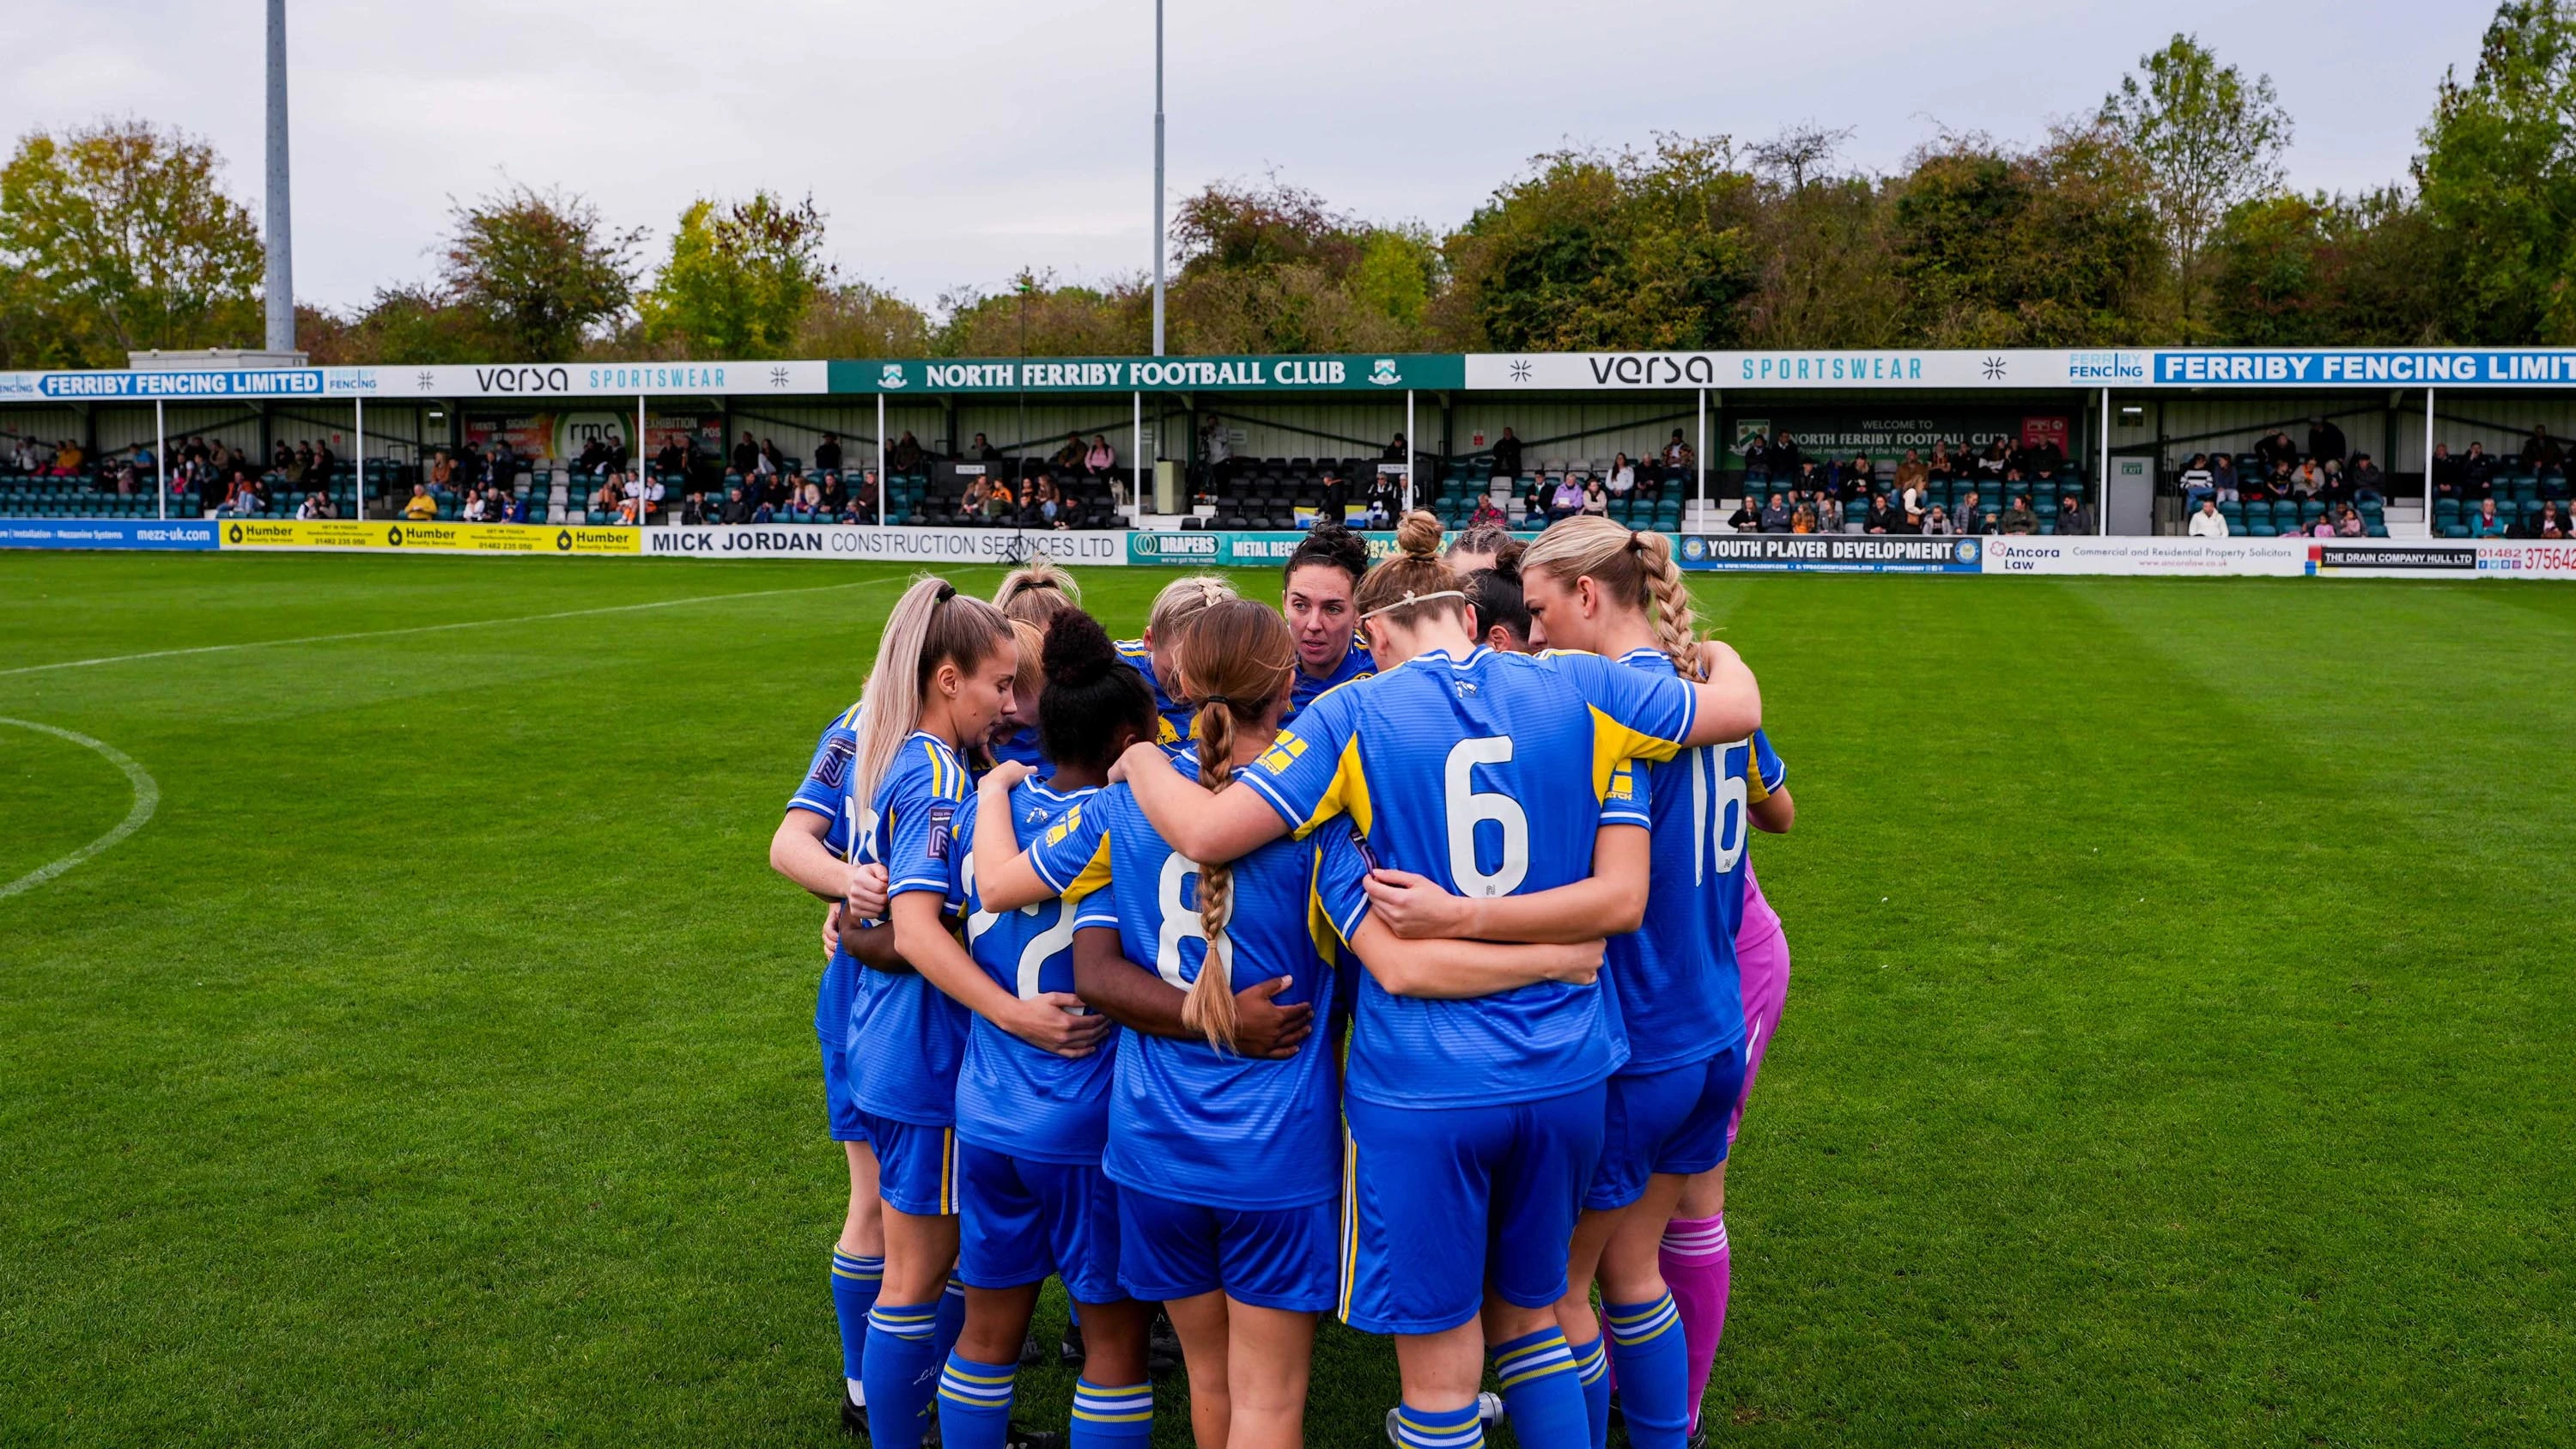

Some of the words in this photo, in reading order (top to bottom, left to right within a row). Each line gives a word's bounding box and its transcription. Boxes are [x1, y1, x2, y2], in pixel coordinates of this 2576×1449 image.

[927, 364, 1014, 387] NORTH
[1022, 363, 1122, 387] FERRIBY
[1129, 362, 1266, 385] FOOTBALL
[1273, 361, 1346, 384] CLUB
[1742, 358, 1922, 380] SPORTSWEAR
[2069, 358, 2142, 377] FENCING
[2165, 356, 2312, 380] FERRIBY
[2323, 356, 2476, 380] FENCING
[2488, 356, 2576, 380] LIMIT
[46, 375, 131, 395] FERRIBY
[136, 374, 227, 394] FENCING
[233, 373, 318, 393] LIMITED
[330, 373, 376, 389] FENCING
[590, 368, 726, 387] SPORTSWEAR
[570, 423, 616, 441] rmc
[1862, 420, 1915, 429] WELCOME
[1917, 420, 1933, 429] TO
[1789, 433, 1835, 446] NORTH
[1839, 433, 1893, 445] FERRIBY
[137, 527, 210, 541] mezz-uk.com
[246, 525, 293, 536] Humber
[406, 527, 457, 539] Humber
[577, 531, 629, 543] Humber
[653, 533, 714, 551] MICK
[722, 533, 823, 551] JORDAN
[831, 533, 975, 554] CONSTRUCTION
[981, 536, 1074, 557] SERVICES
[1080, 538, 1115, 557] LTD
[1160, 536, 1216, 554] DRAPERS
[1232, 541, 1268, 557] METAL
[1708, 540, 1761, 557] YOUTH
[1766, 541, 1828, 558] PLAYER
[1832, 541, 1953, 559] DEVELOPMENT
[2006, 547, 2060, 558] Ancora
[2073, 546, 2128, 556] Commercial
[2131, 547, 2148, 556] and
[2153, 547, 2202, 557] Residential
[2206, 548, 2246, 558] Property
[2250, 548, 2292, 557] Solicitors
[2478, 549, 2522, 557] 01482
[2005, 560, 2034, 569] Law
[2325, 552, 2344, 563] THE
[2346, 552, 2376, 563] DRAIN
[2378, 553, 2427, 563] COMPANY
[2430, 553, 2452, 563] HULL
[2454, 554, 2473, 564] LTD
[1605, 790, 1632, 801] ATCH
[1444, 734, 1529, 898] 6
[1692, 737, 1748, 887] 16
[1158, 850, 1235, 992] 8
